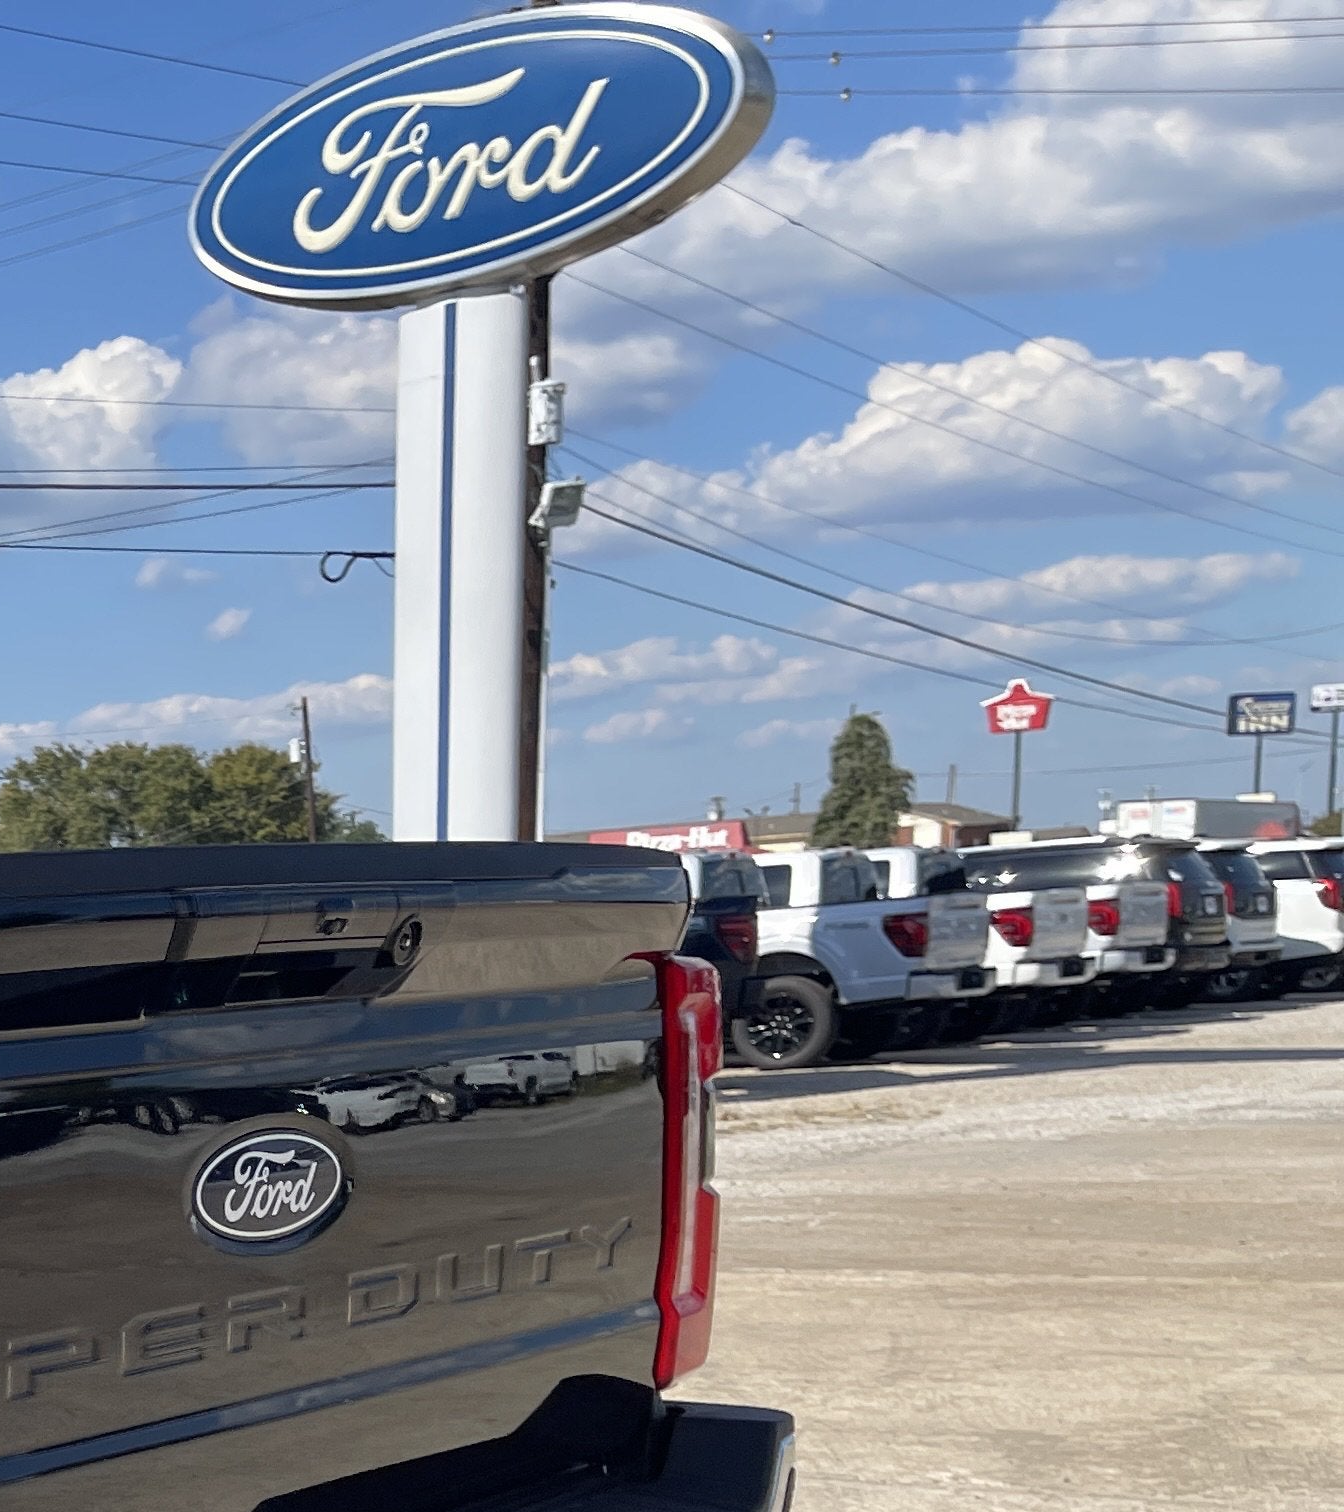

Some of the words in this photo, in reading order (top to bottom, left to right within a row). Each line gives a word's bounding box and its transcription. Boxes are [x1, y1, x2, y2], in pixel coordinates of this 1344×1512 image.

[292, 67, 611, 254] Ford
[224, 1149, 318, 1223] Ford
[346, 1215, 634, 1327] DUTY
